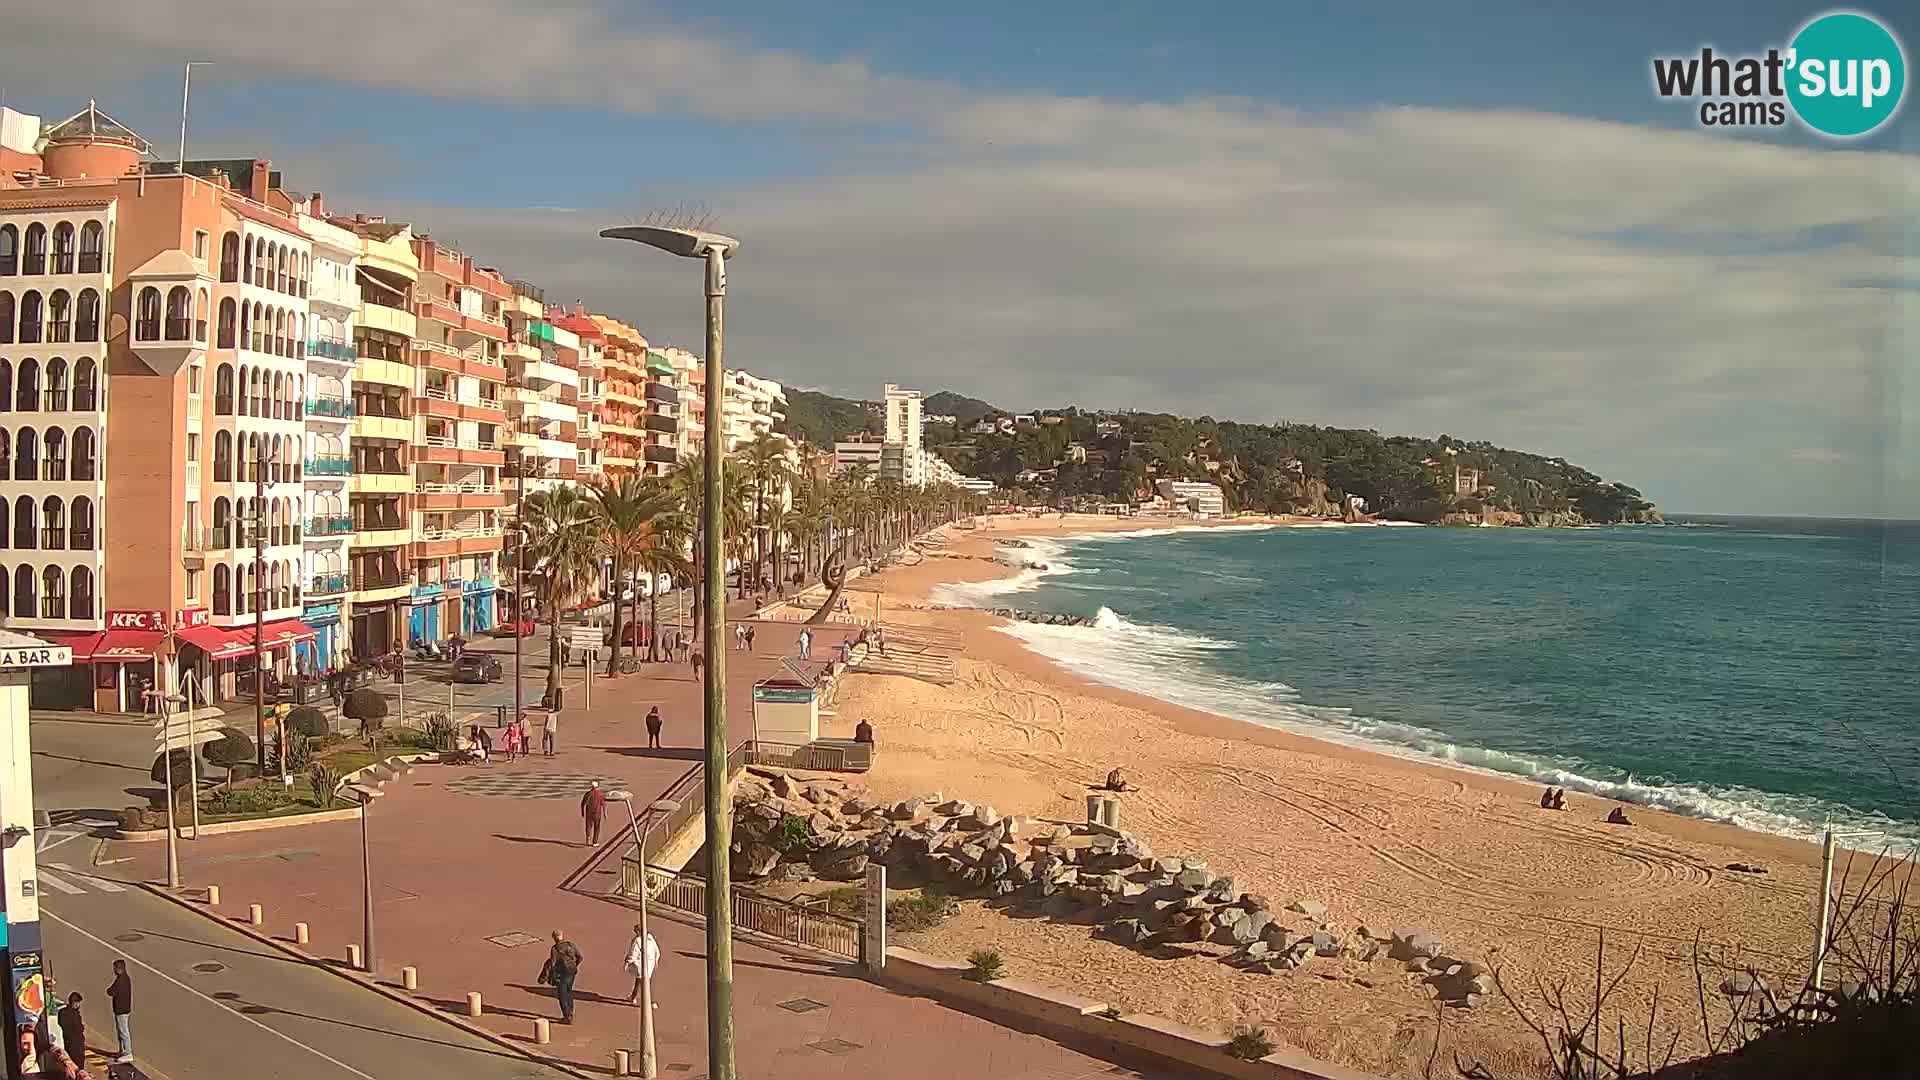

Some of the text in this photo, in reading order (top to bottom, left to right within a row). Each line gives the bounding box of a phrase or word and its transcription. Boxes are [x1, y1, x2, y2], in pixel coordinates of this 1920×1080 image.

[111, 612, 147, 627] KFC
[191, 610, 209, 625] KFC
[18, 650, 51, 664] BAR
[106, 647, 145, 655] KFC
